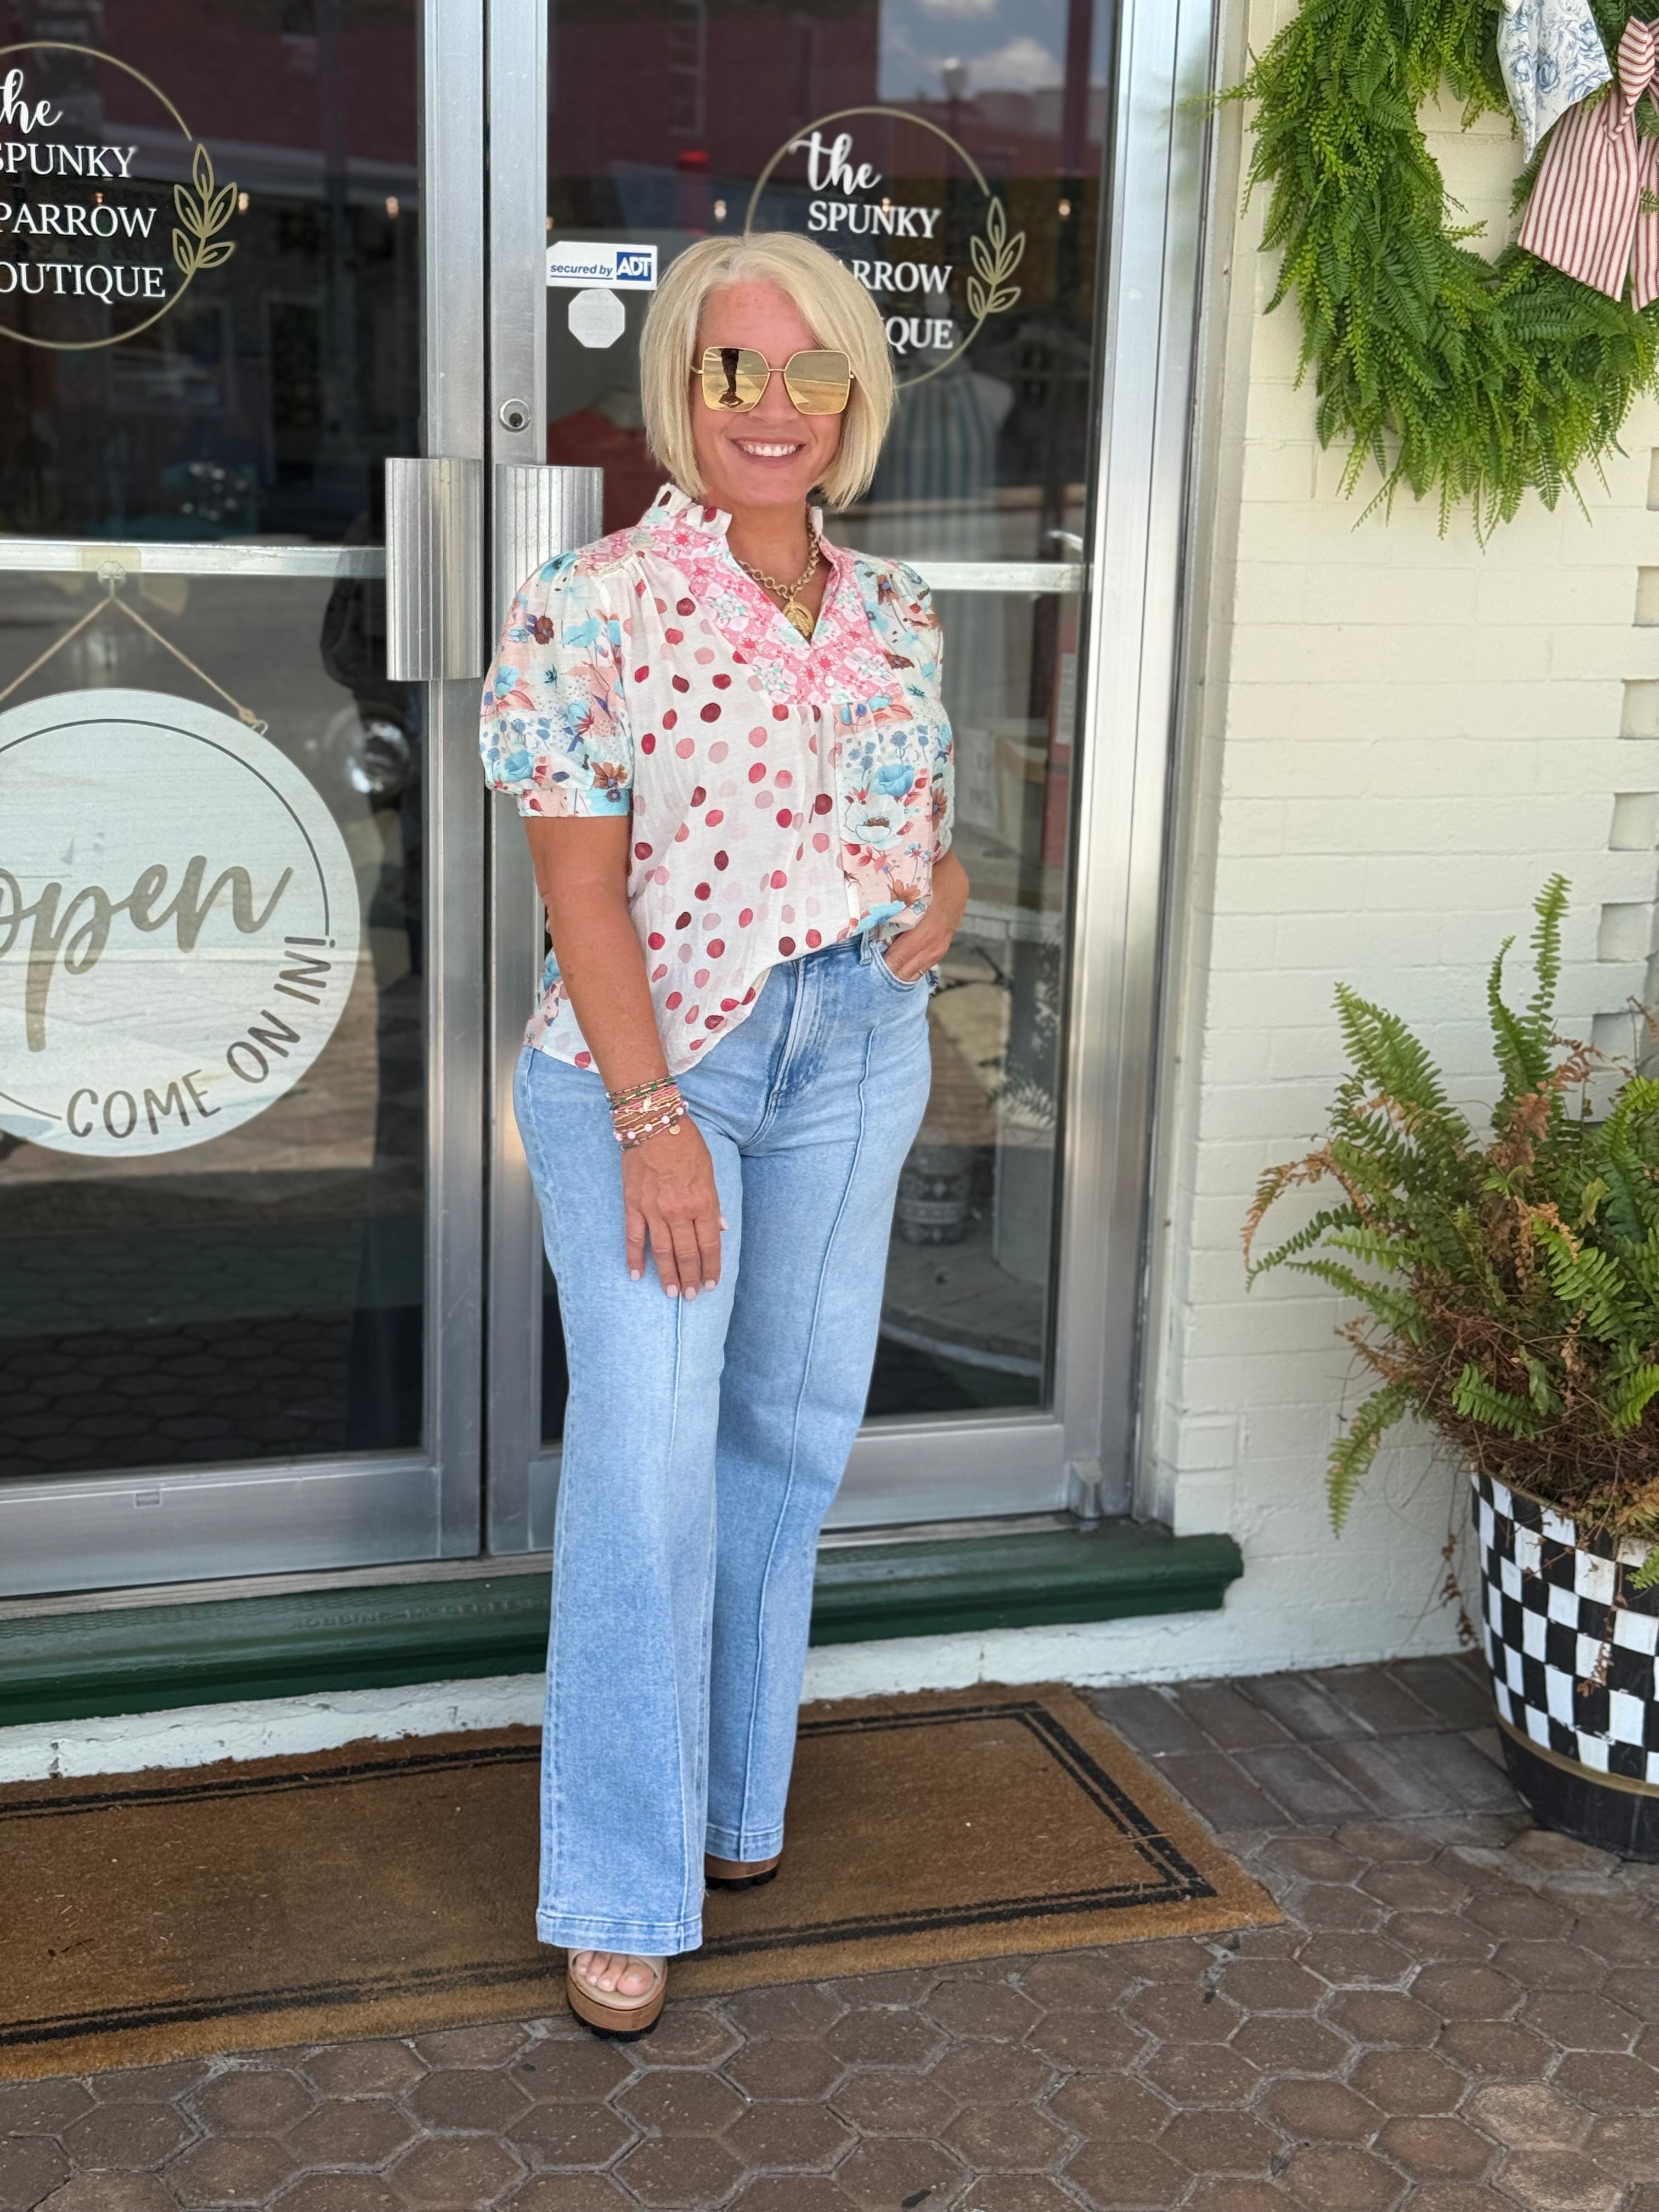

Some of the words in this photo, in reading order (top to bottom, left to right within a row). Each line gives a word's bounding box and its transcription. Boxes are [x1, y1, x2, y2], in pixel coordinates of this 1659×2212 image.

[0, 68, 63, 134] he
[0, 142, 138, 178] PUNKY
[788, 131, 882, 195] the
[808, 200, 941, 239] SPUNKY
[550, 264, 597, 274] secured
[599, 265, 613, 276] by
[617, 256, 652, 277] ADT
[850, 259, 952, 294] RROW
[884, 315, 953, 354] QUE
[66, 1069, 222, 1139] COME
[225, 1009, 301, 1084] ON
[273, 935, 336, 1006] IN!
